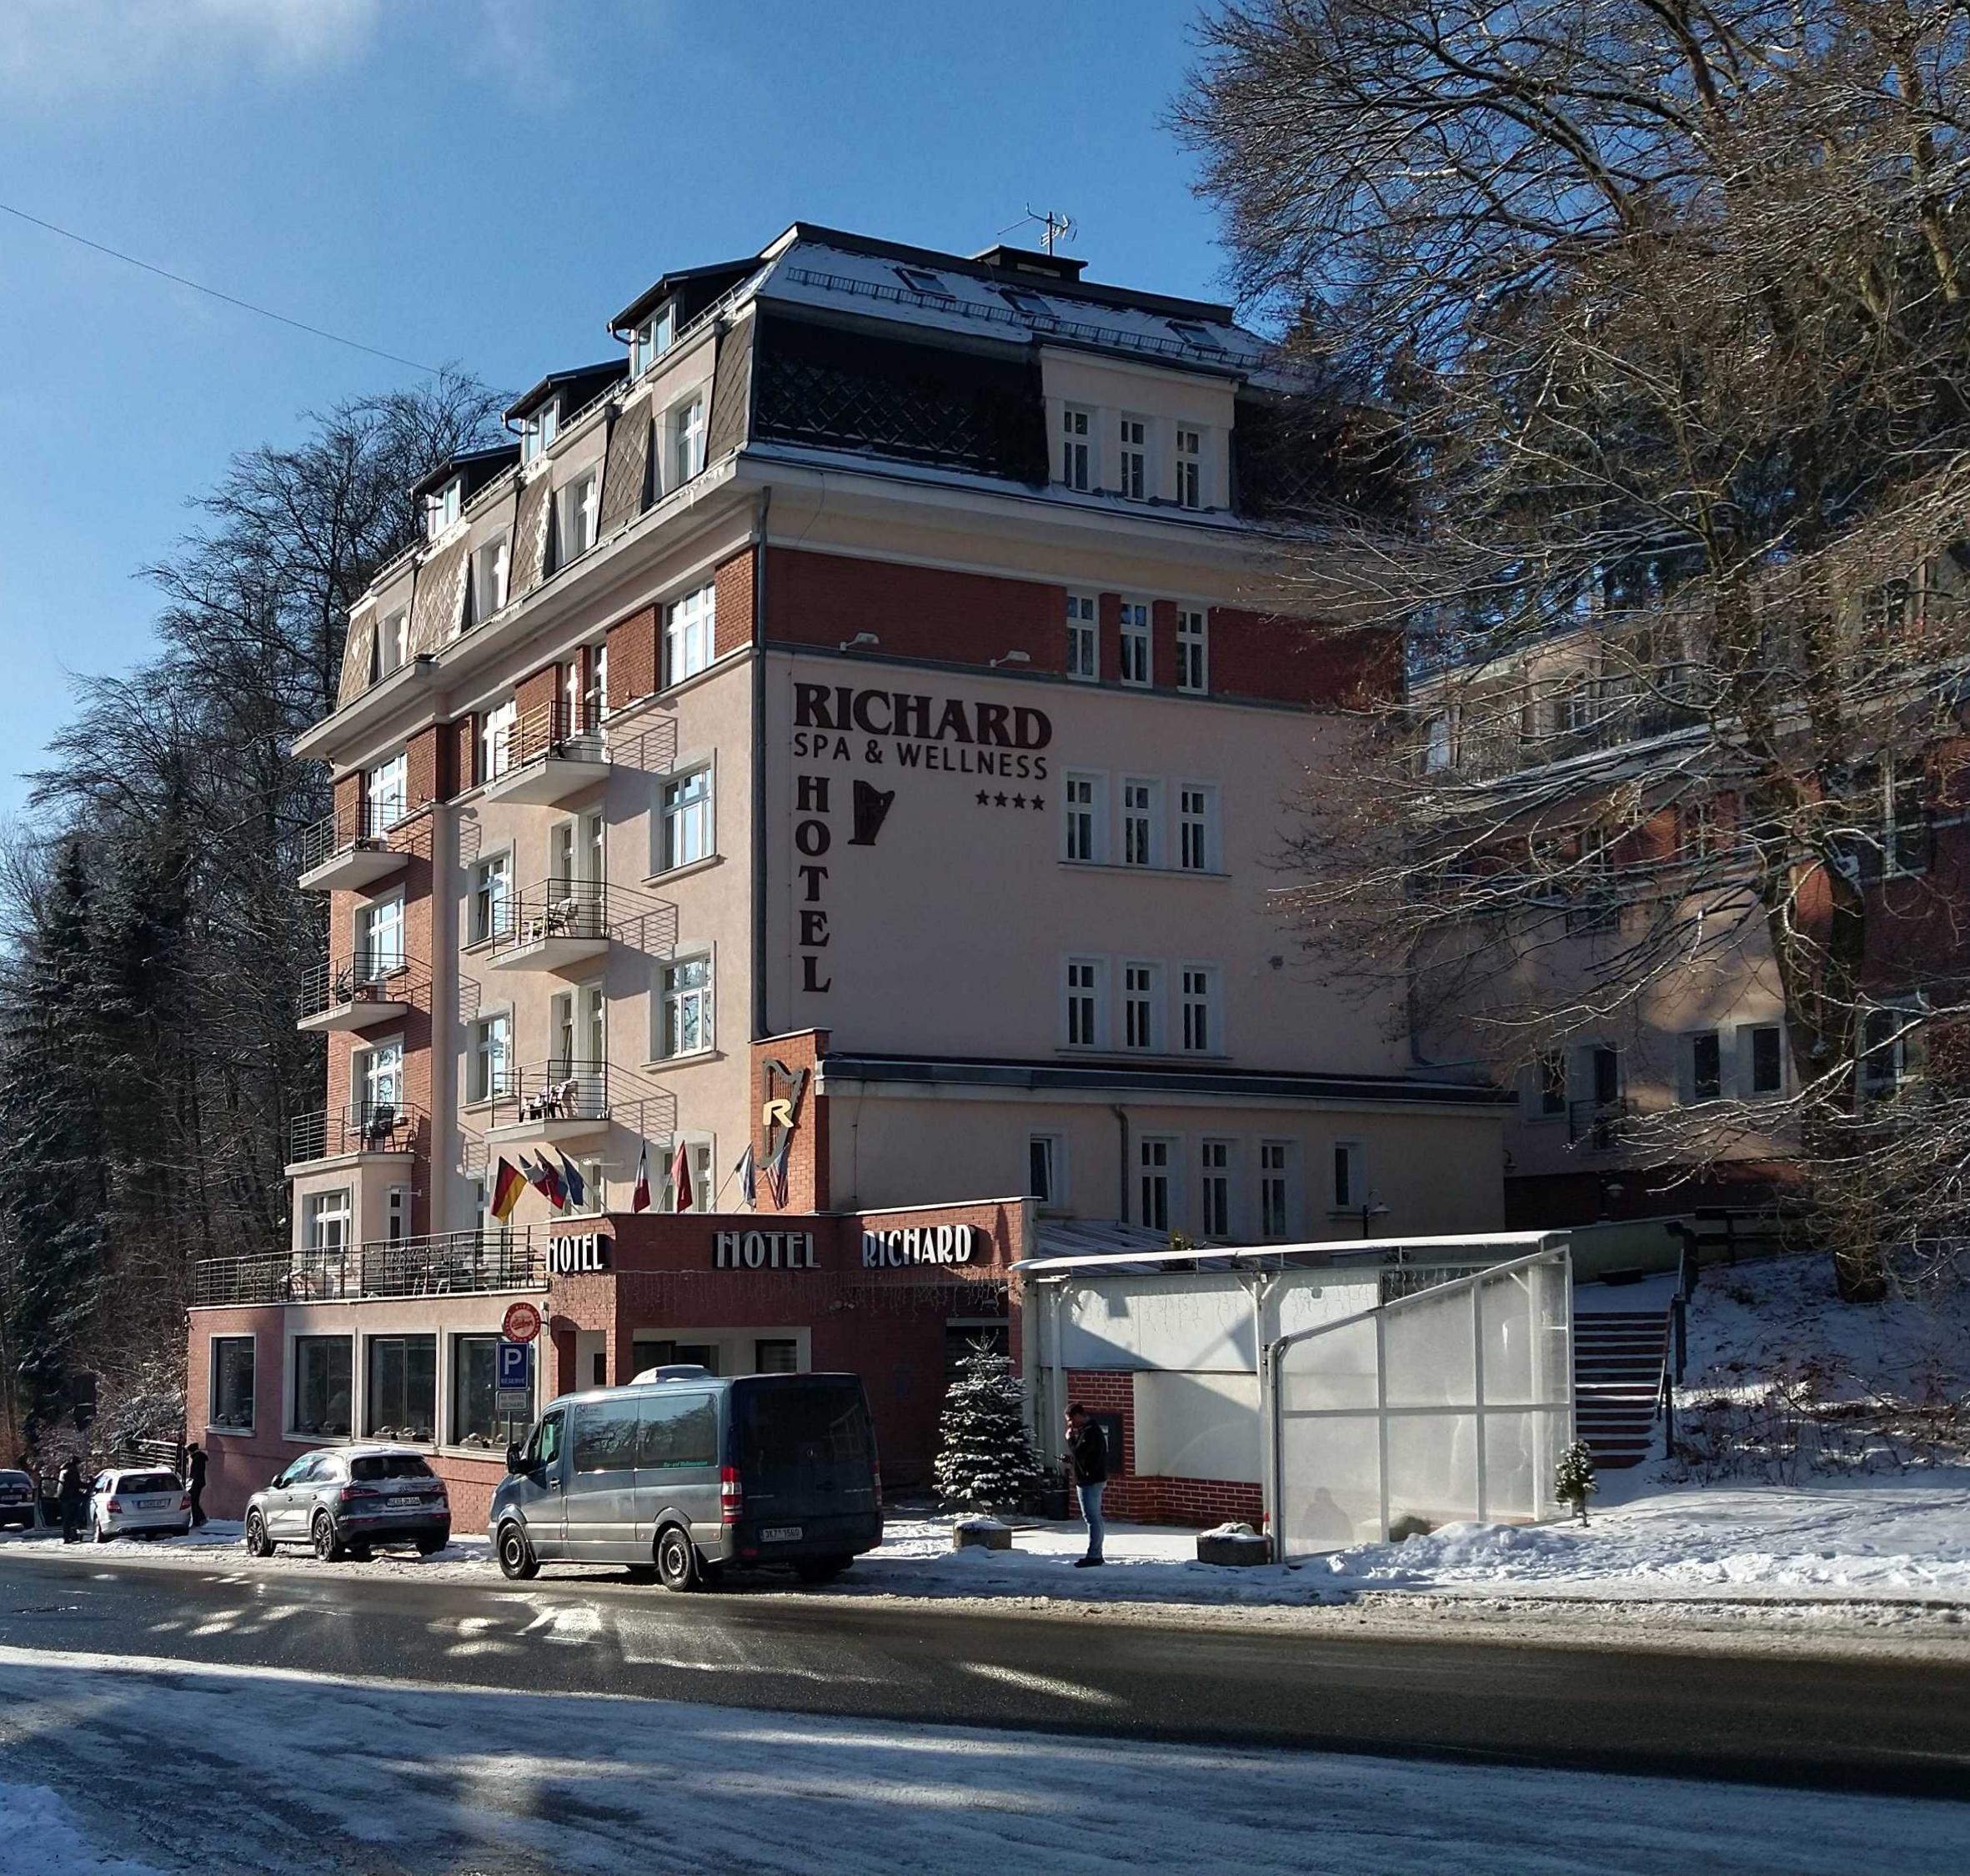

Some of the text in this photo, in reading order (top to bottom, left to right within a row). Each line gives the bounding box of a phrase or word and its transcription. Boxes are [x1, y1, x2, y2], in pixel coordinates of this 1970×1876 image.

[793, 682, 1053, 750] RICHARD
[794, 732, 1048, 780] SPA & WELLNESS
[795, 775, 831, 993] HOTEL
[763, 1098, 794, 1128] R
[546, 1233, 604, 1274] HOTEL
[716, 1224, 972, 1269] HOTEL RICHARD
[504, 1347, 523, 1375] P
